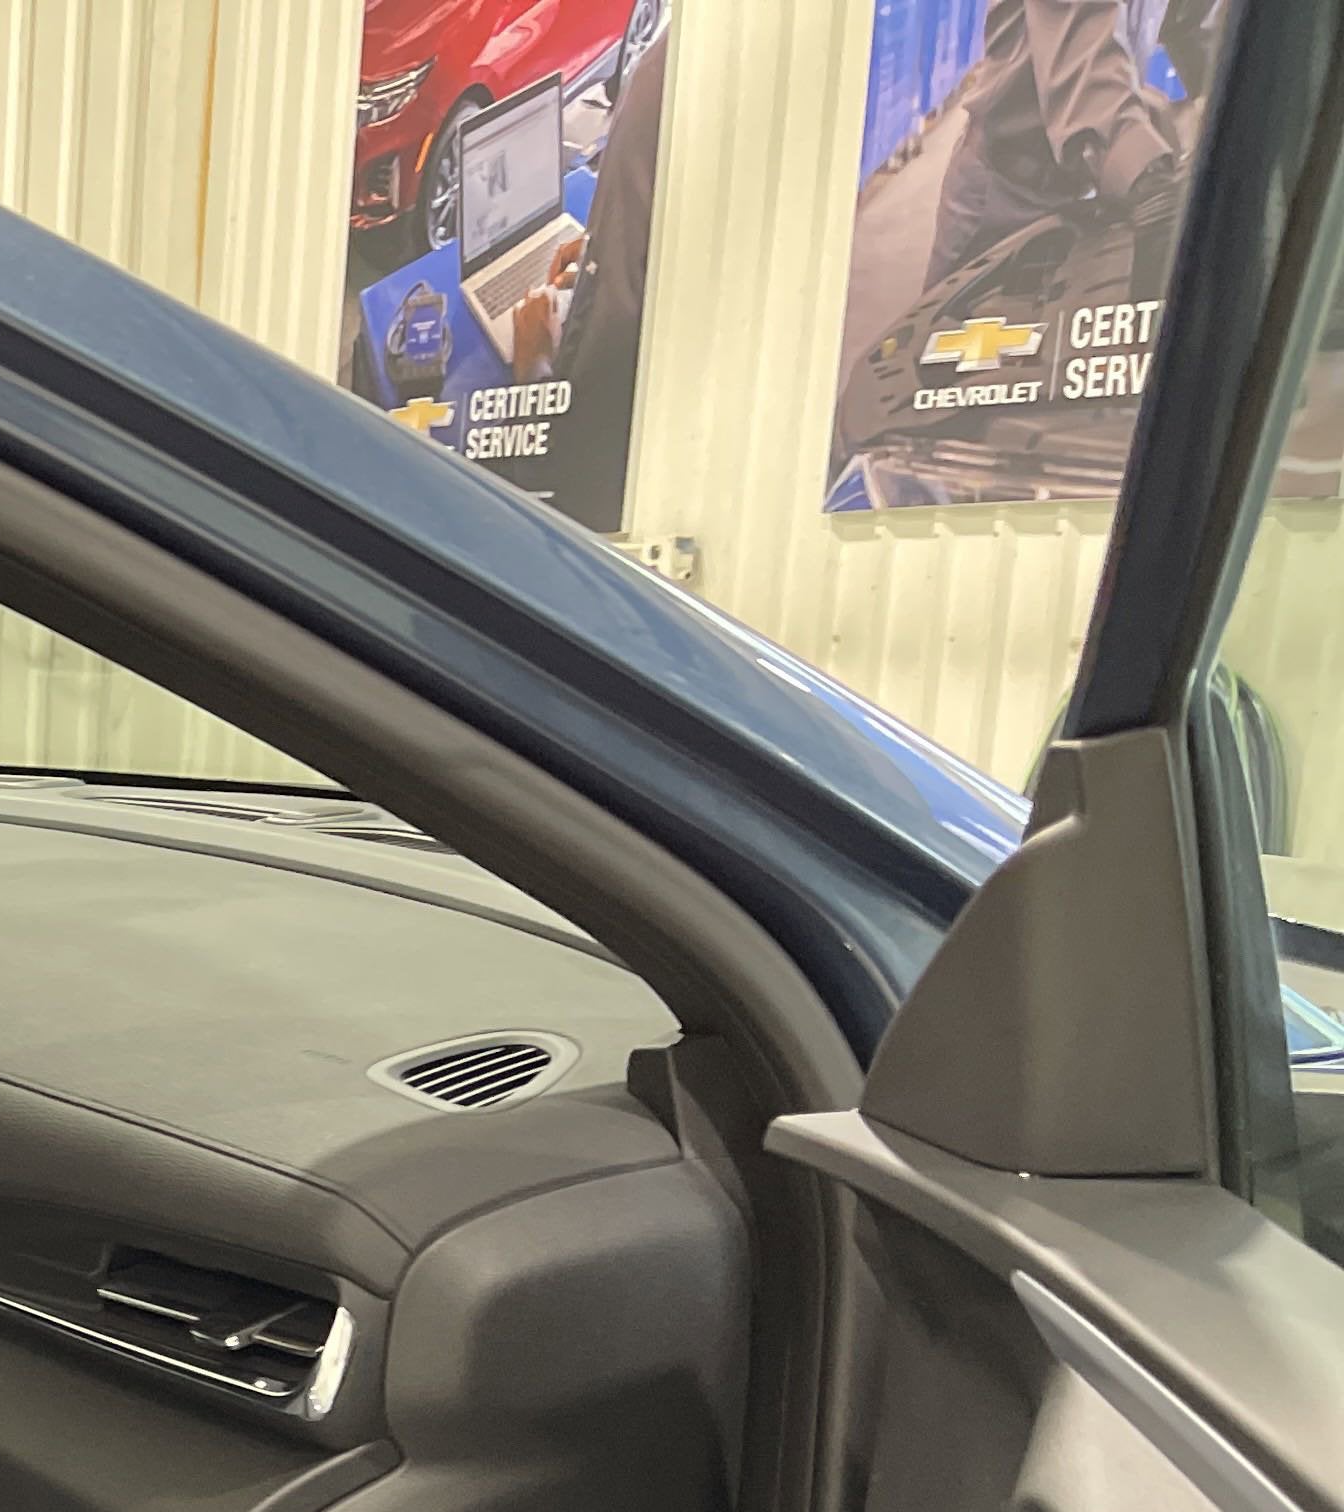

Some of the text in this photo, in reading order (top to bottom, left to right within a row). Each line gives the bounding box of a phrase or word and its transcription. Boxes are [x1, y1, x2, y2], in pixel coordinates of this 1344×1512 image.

[469, 380, 572, 422] CERTIFIED
[913, 381, 1043, 410] CHEVROLET
[465, 422, 551, 460] SERVICE
